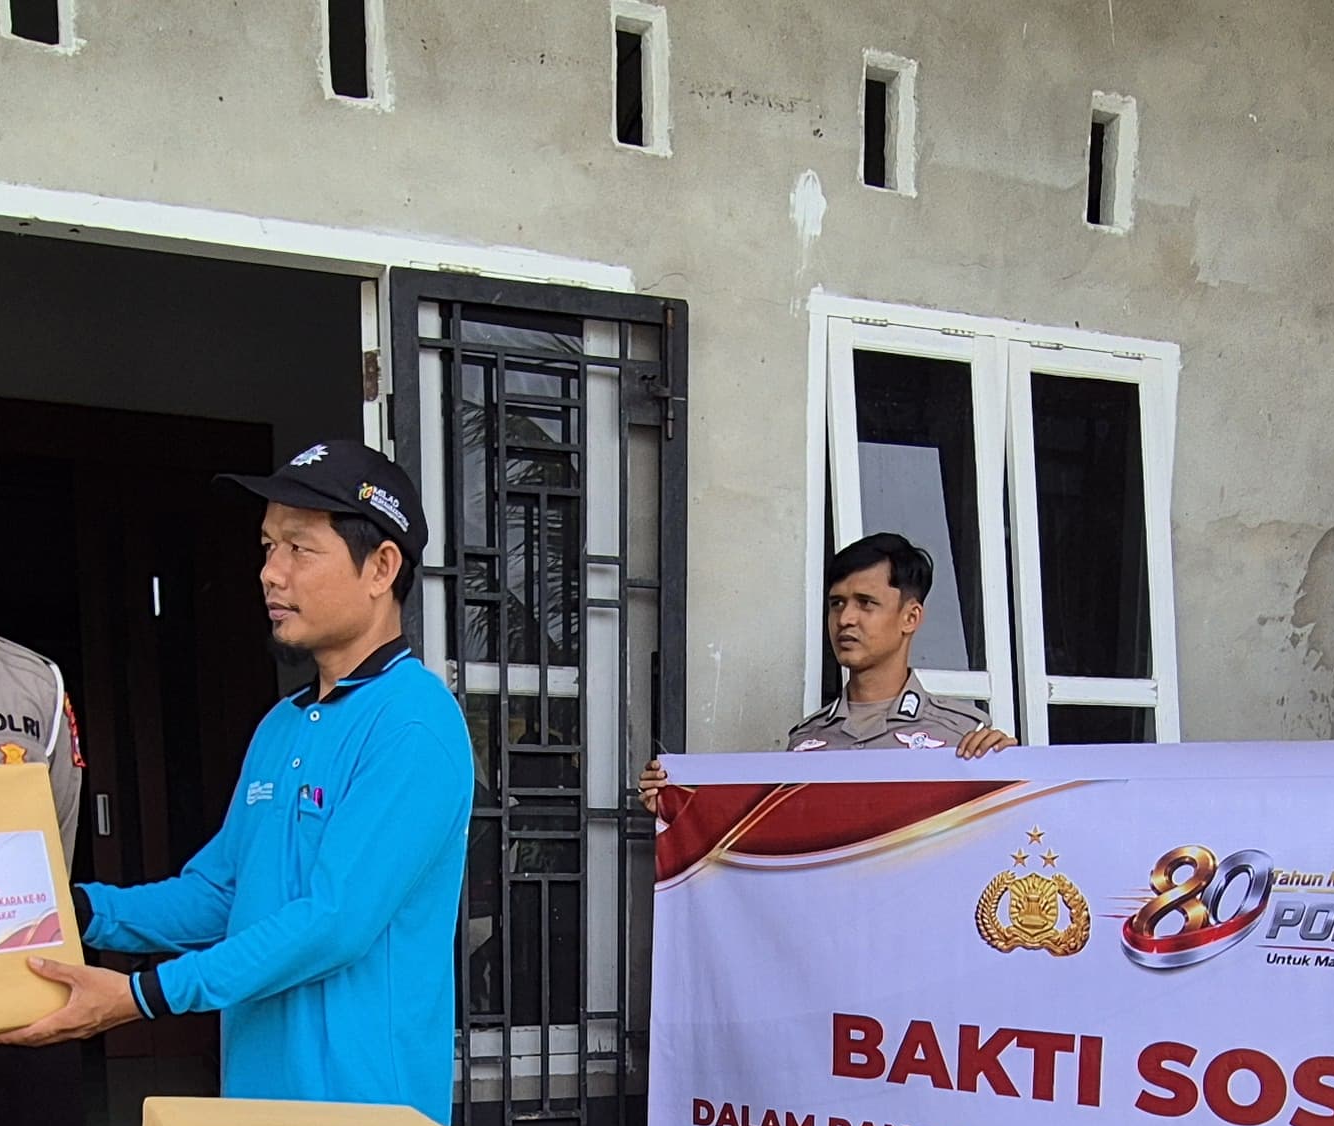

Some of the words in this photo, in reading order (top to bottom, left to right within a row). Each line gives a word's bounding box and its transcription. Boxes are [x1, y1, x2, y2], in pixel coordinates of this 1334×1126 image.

[1132, 844, 1273, 938] 80
[1271, 869, 1323, 887] Tahun
[1266, 953, 1310, 967] Untuk
[832, 1011, 1103, 1107] BAKTI
